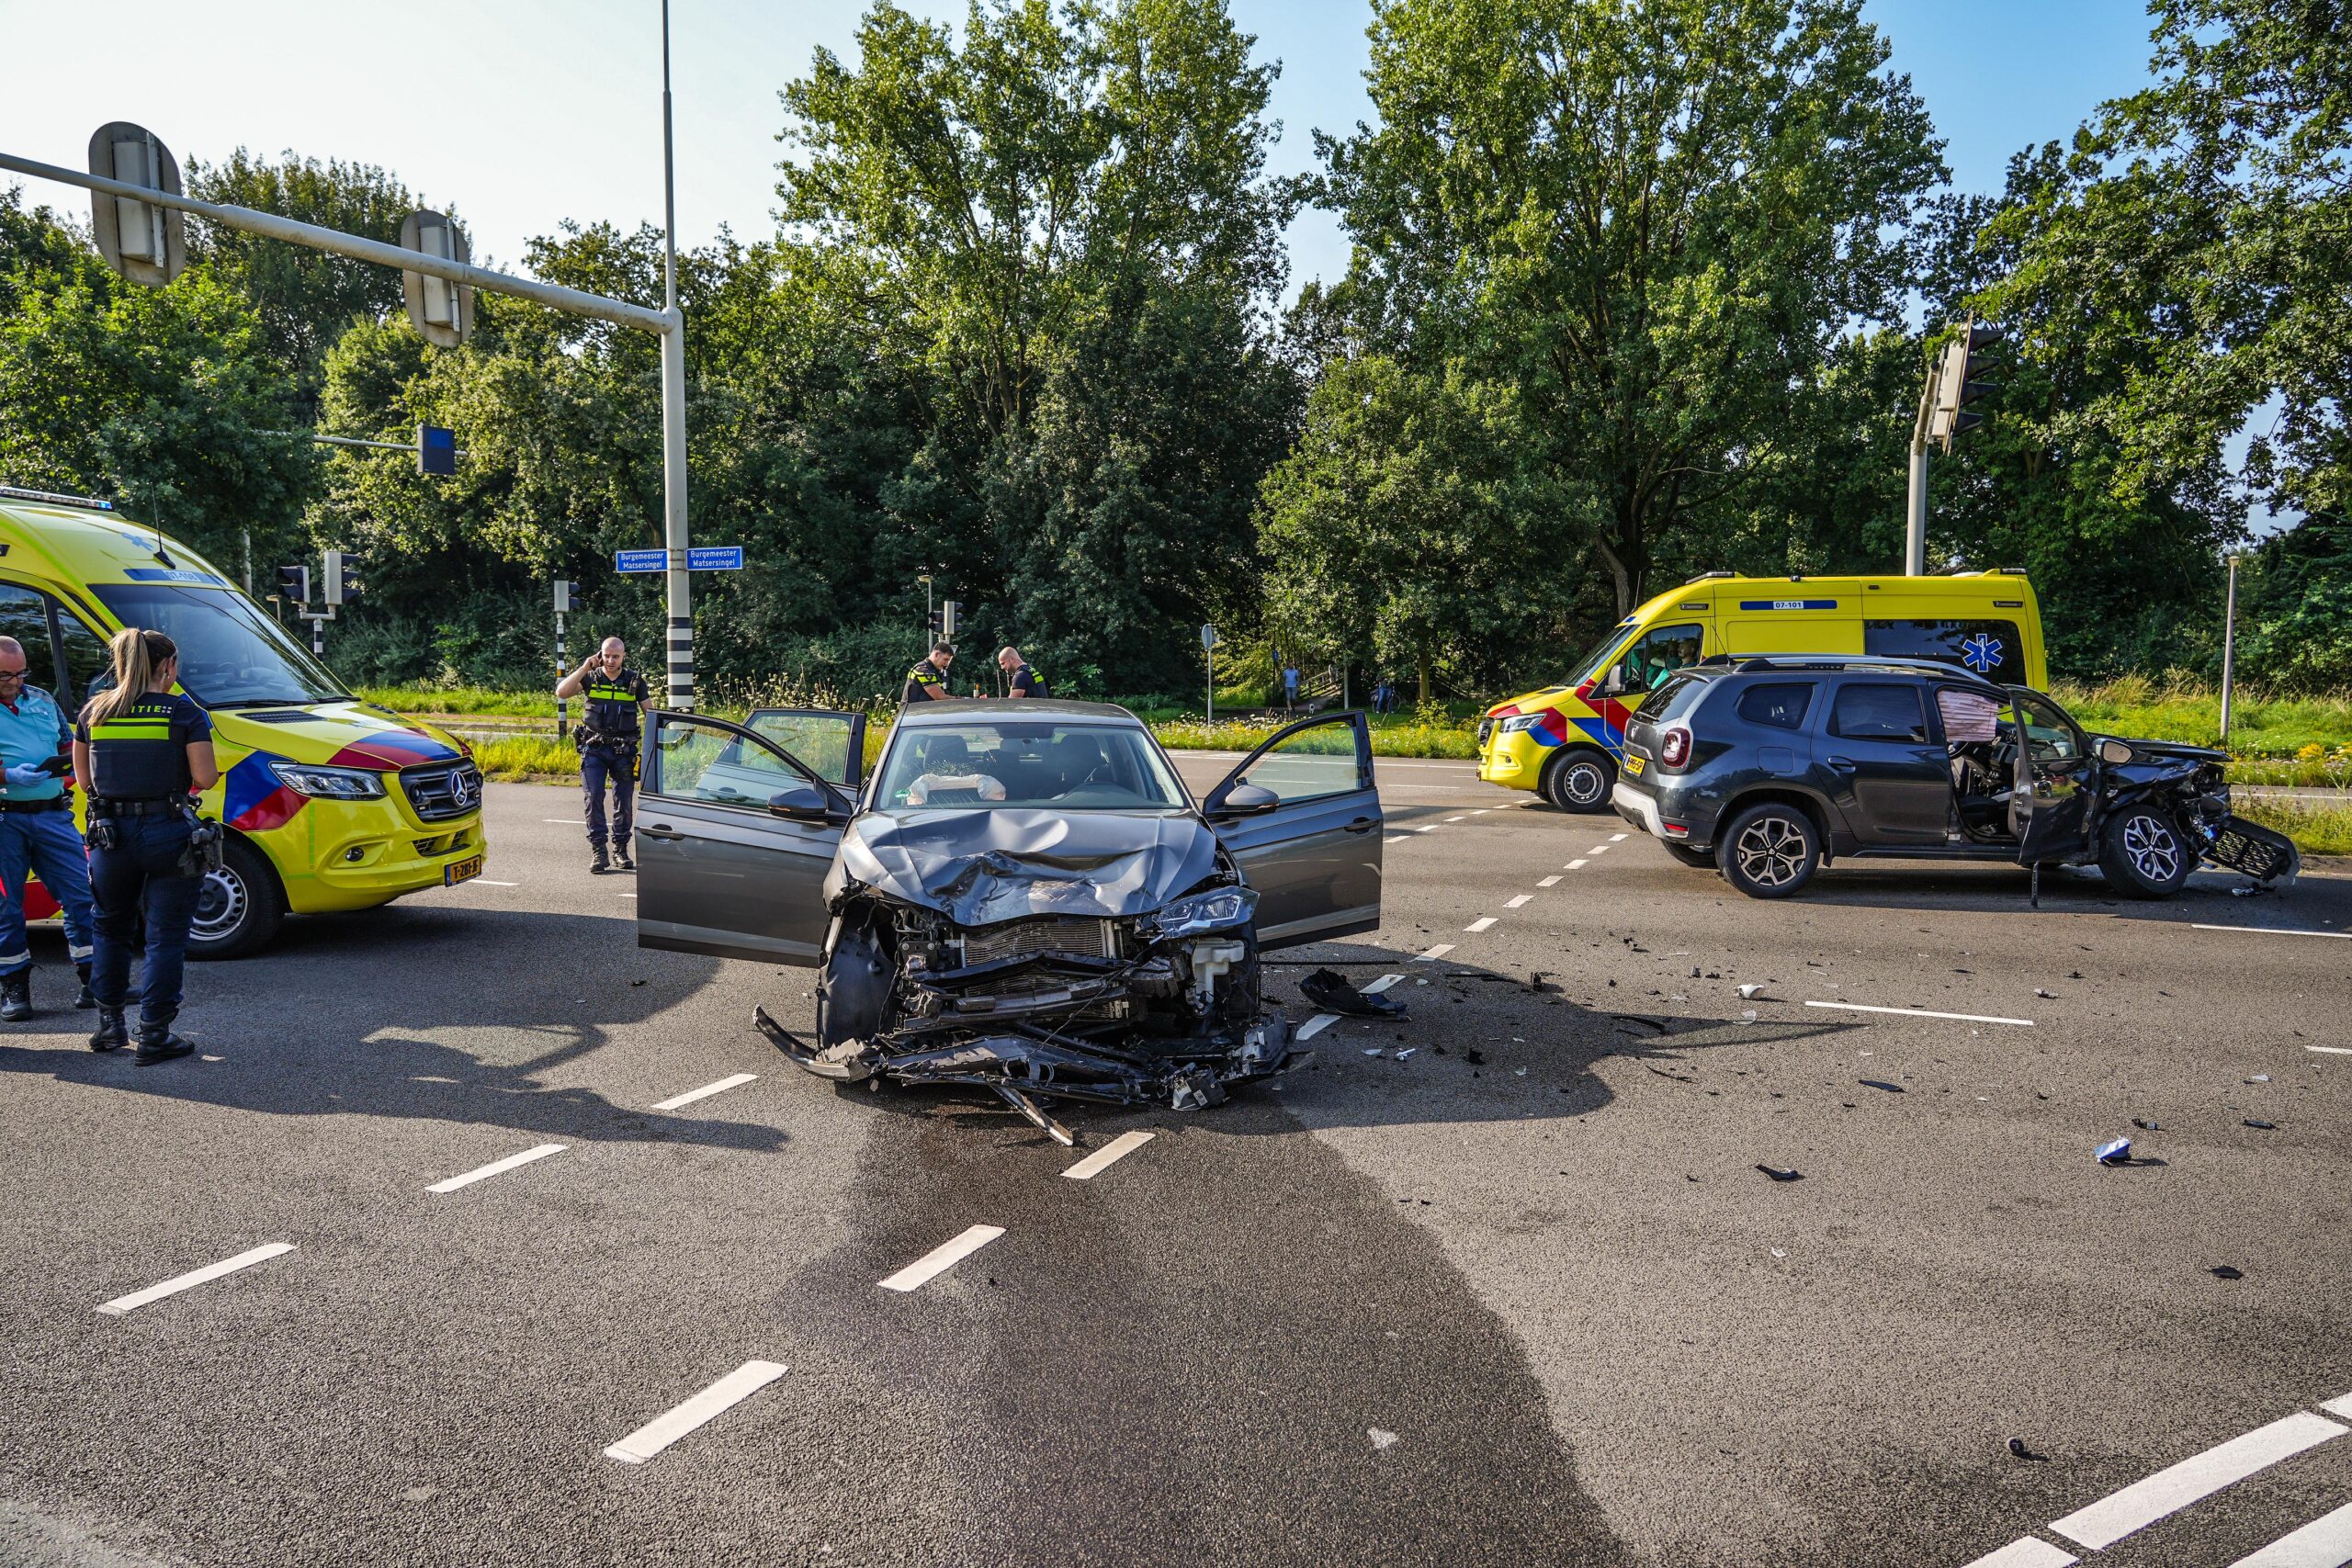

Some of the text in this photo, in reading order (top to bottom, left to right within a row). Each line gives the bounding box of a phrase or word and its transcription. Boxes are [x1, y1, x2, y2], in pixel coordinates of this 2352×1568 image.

[620, 553, 664, 561] Burgemeester
[690, 549, 737, 559] Burgemeester
[623, 560, 662, 570] Matsersingel
[693, 558, 735, 568] Matsersingel
[130, 705, 163, 714] ITIE
